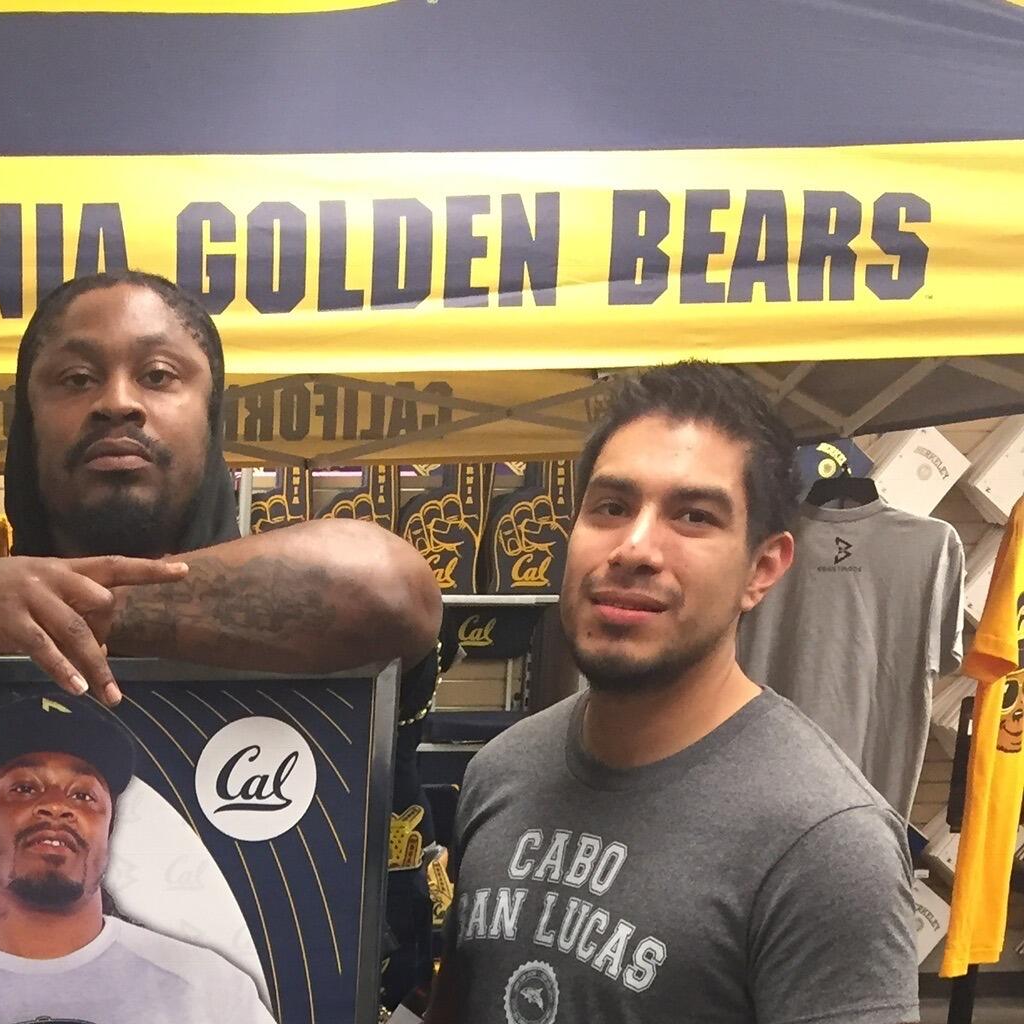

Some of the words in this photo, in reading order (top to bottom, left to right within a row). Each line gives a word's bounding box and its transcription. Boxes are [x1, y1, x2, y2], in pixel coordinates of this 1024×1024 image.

[176, 191, 560, 315] GOLDEN
[607, 188, 932, 305] BEARS
[511, 553, 553, 588] Cal
[458, 614, 497, 647] Cal
[213, 744, 299, 814] Cal
[508, 828, 628, 897] CABO
[533, 891, 668, 993] LUCAS
[914, 903, 940, 931] RKELEY
